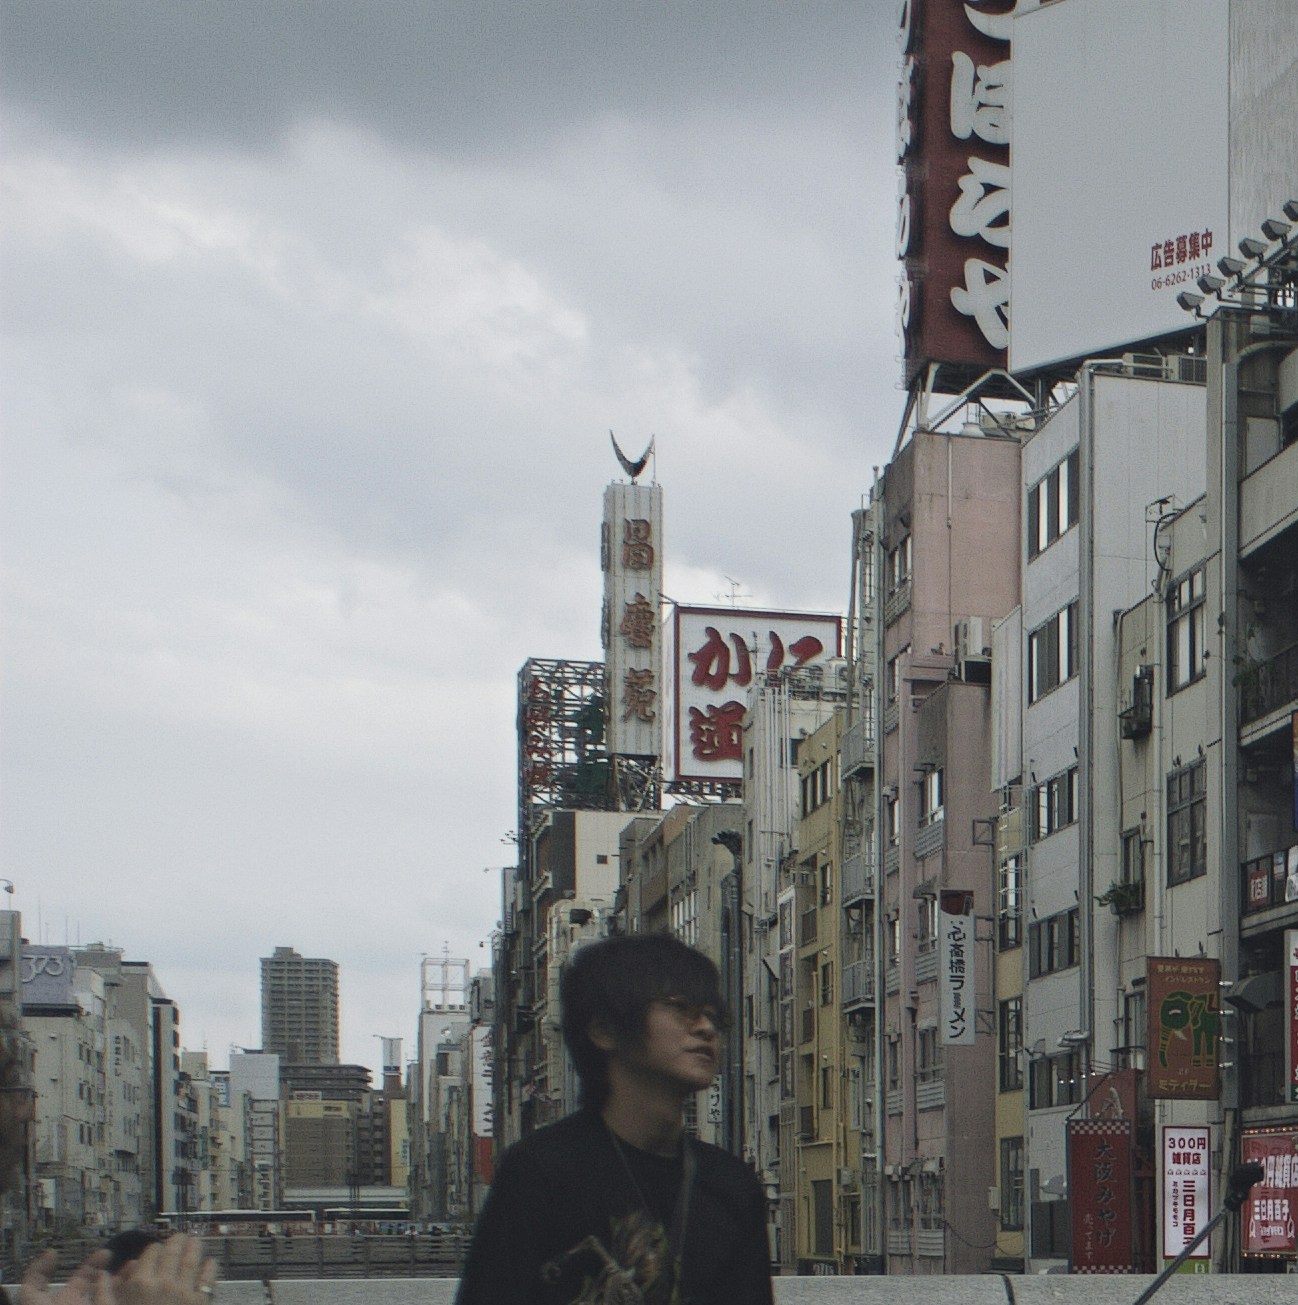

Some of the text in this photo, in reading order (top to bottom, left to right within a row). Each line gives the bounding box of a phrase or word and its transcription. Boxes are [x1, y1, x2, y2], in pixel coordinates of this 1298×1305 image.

[1150, 227, 1213, 271] 広告募集中
[1169, 1137, 1206, 1151] 300円
[1094, 1136, 1118, 1249] 大阪みやげ
